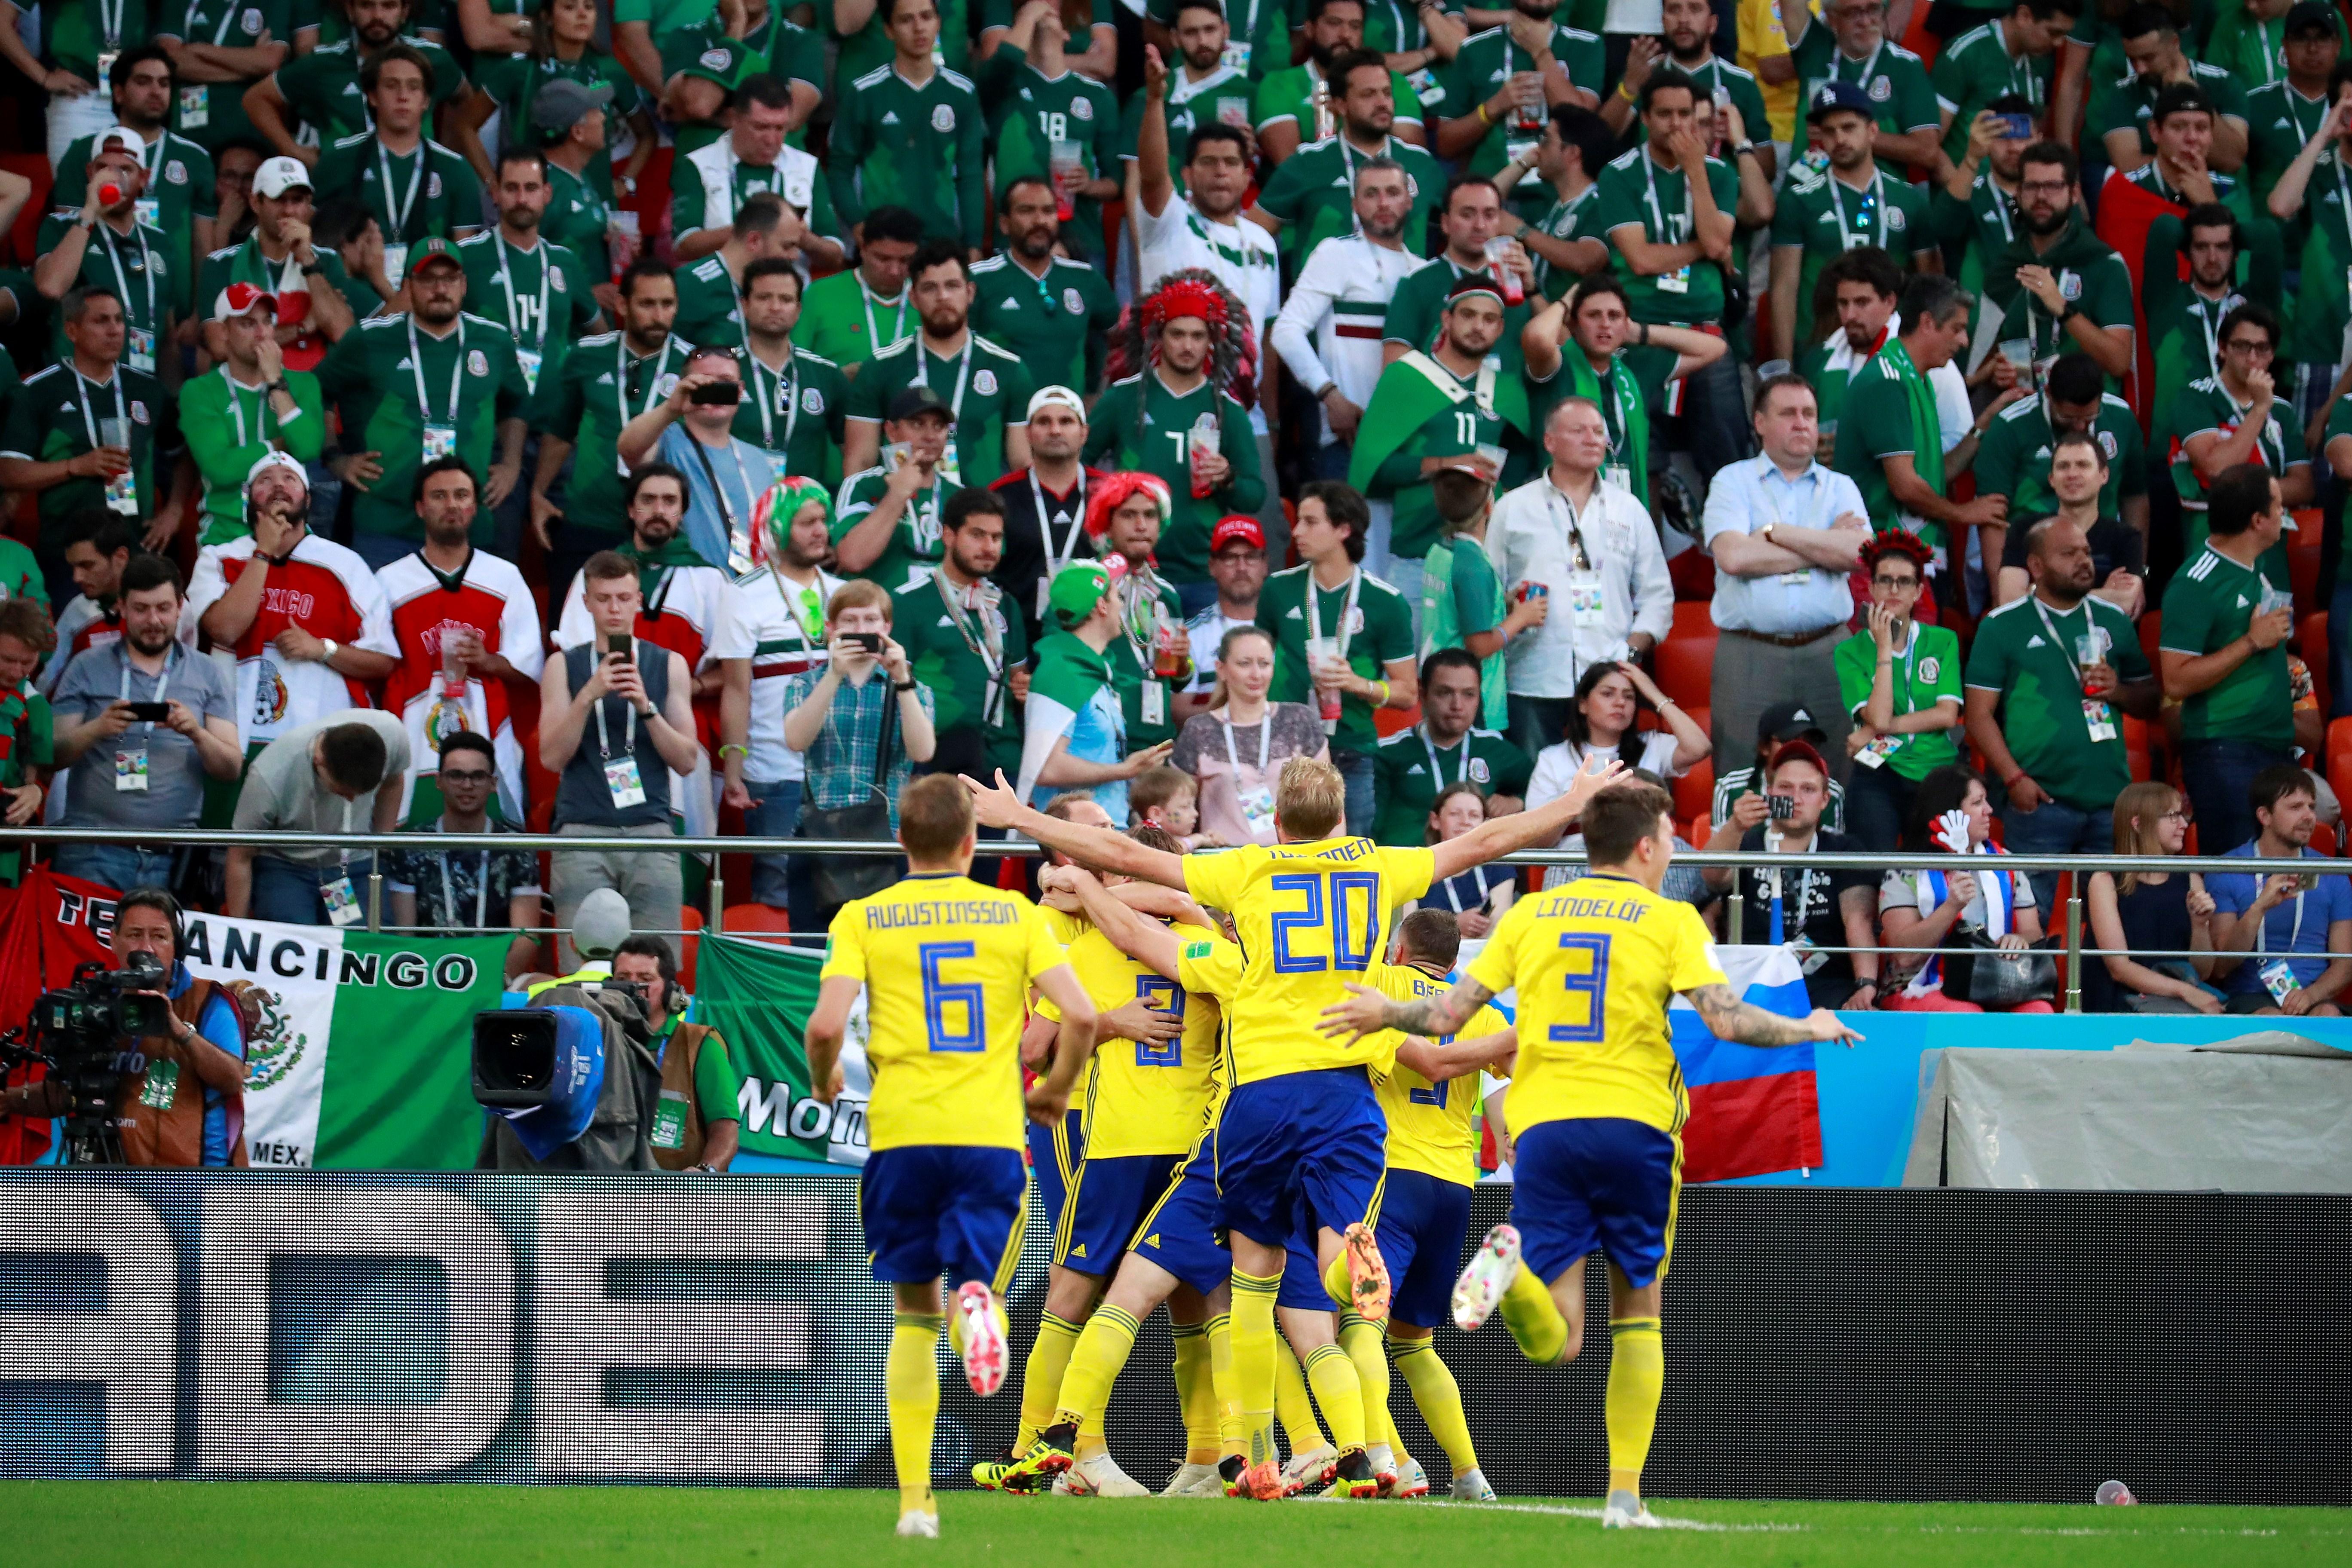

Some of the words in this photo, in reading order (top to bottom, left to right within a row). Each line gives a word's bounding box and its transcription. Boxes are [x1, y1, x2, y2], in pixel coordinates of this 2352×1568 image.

[1038, 110, 1067, 141] 18
[1455, 411, 1476, 446] 11
[1165, 431, 1184, 464] 7
[866, 901, 1019, 930] AUGUSTINSSON
[1271, 871, 1379, 973] 20
[1536, 897, 1652, 923] LINDELÖF
[919, 940, 986, 1053] 6
[1549, 932, 1612, 1043] 3
[252, 1139, 305, 1167] MÉX.
